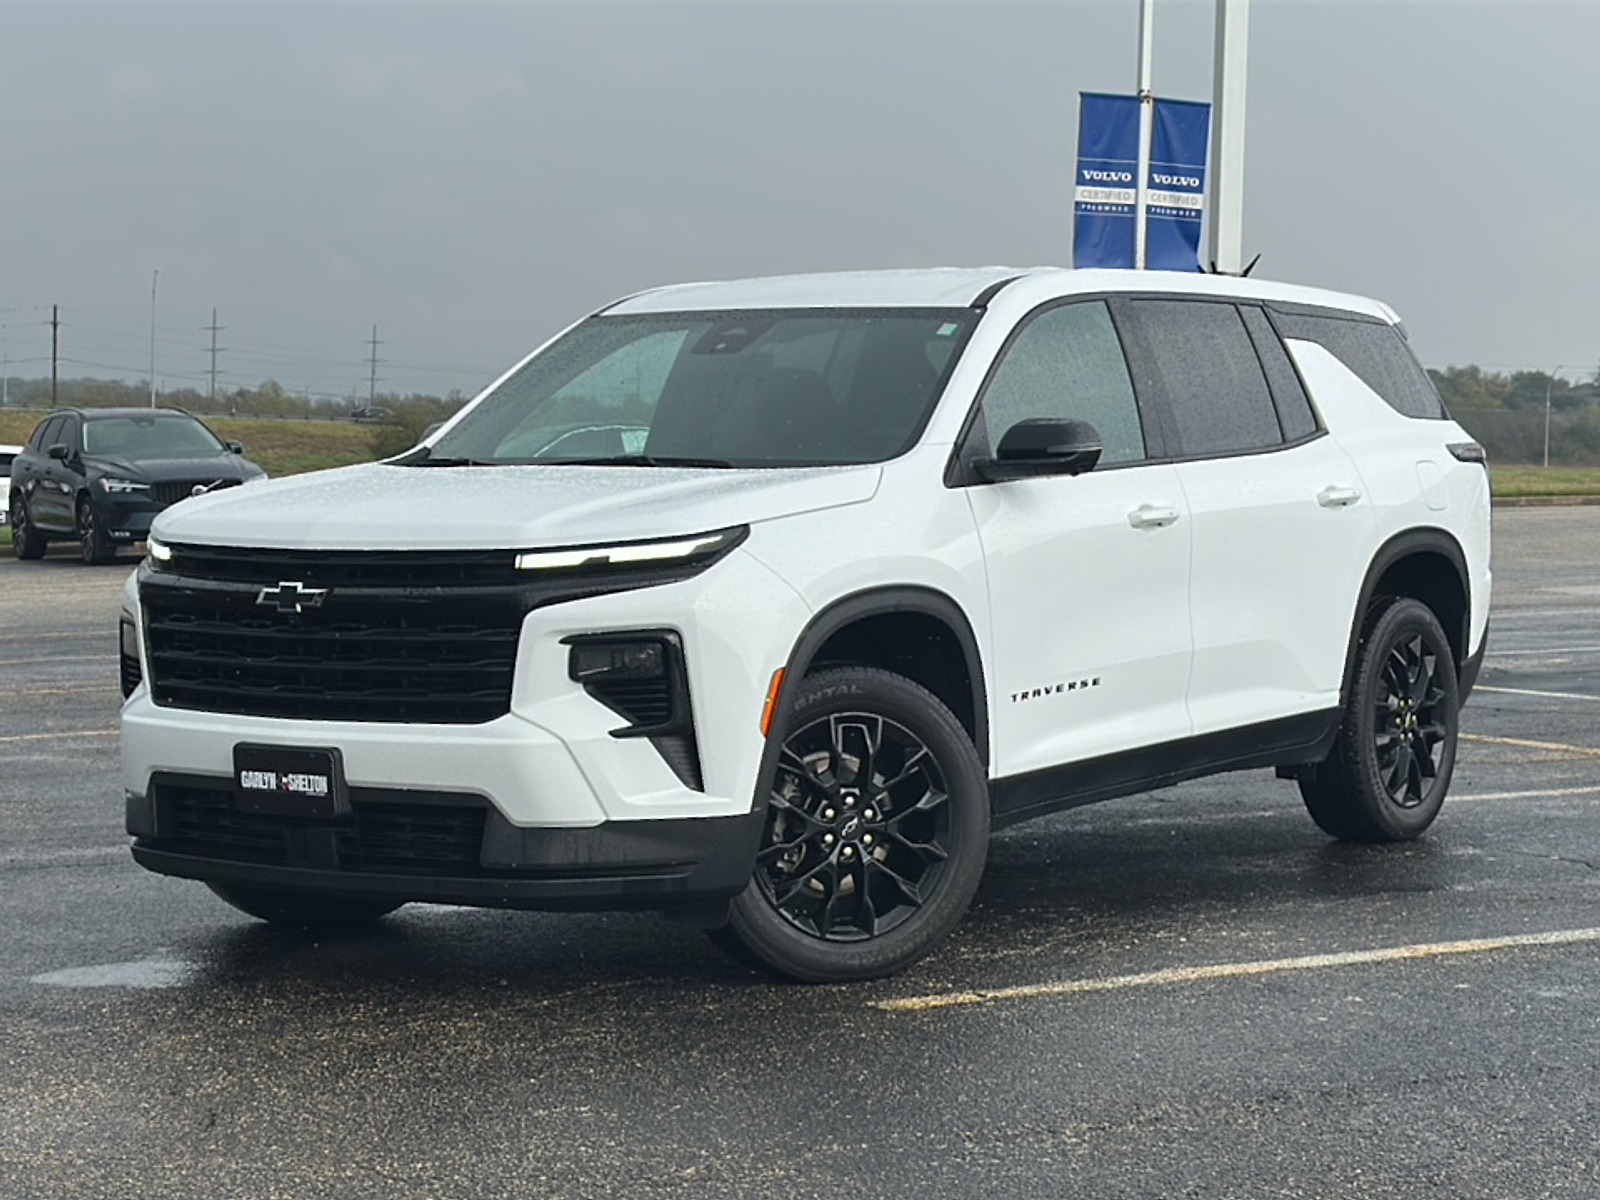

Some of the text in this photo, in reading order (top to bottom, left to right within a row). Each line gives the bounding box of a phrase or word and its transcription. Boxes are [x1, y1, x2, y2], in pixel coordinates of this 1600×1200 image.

[1082, 169, 1132, 183] VOLVO
[1152, 173, 1200, 187] VOLVO
[1080, 188, 1131, 201] CERTIFIED
[1150, 192, 1198, 206] CERTIFIED
[1011, 677, 1100, 702] TRAVERSE
[287, 773, 328, 793] SHELTON
